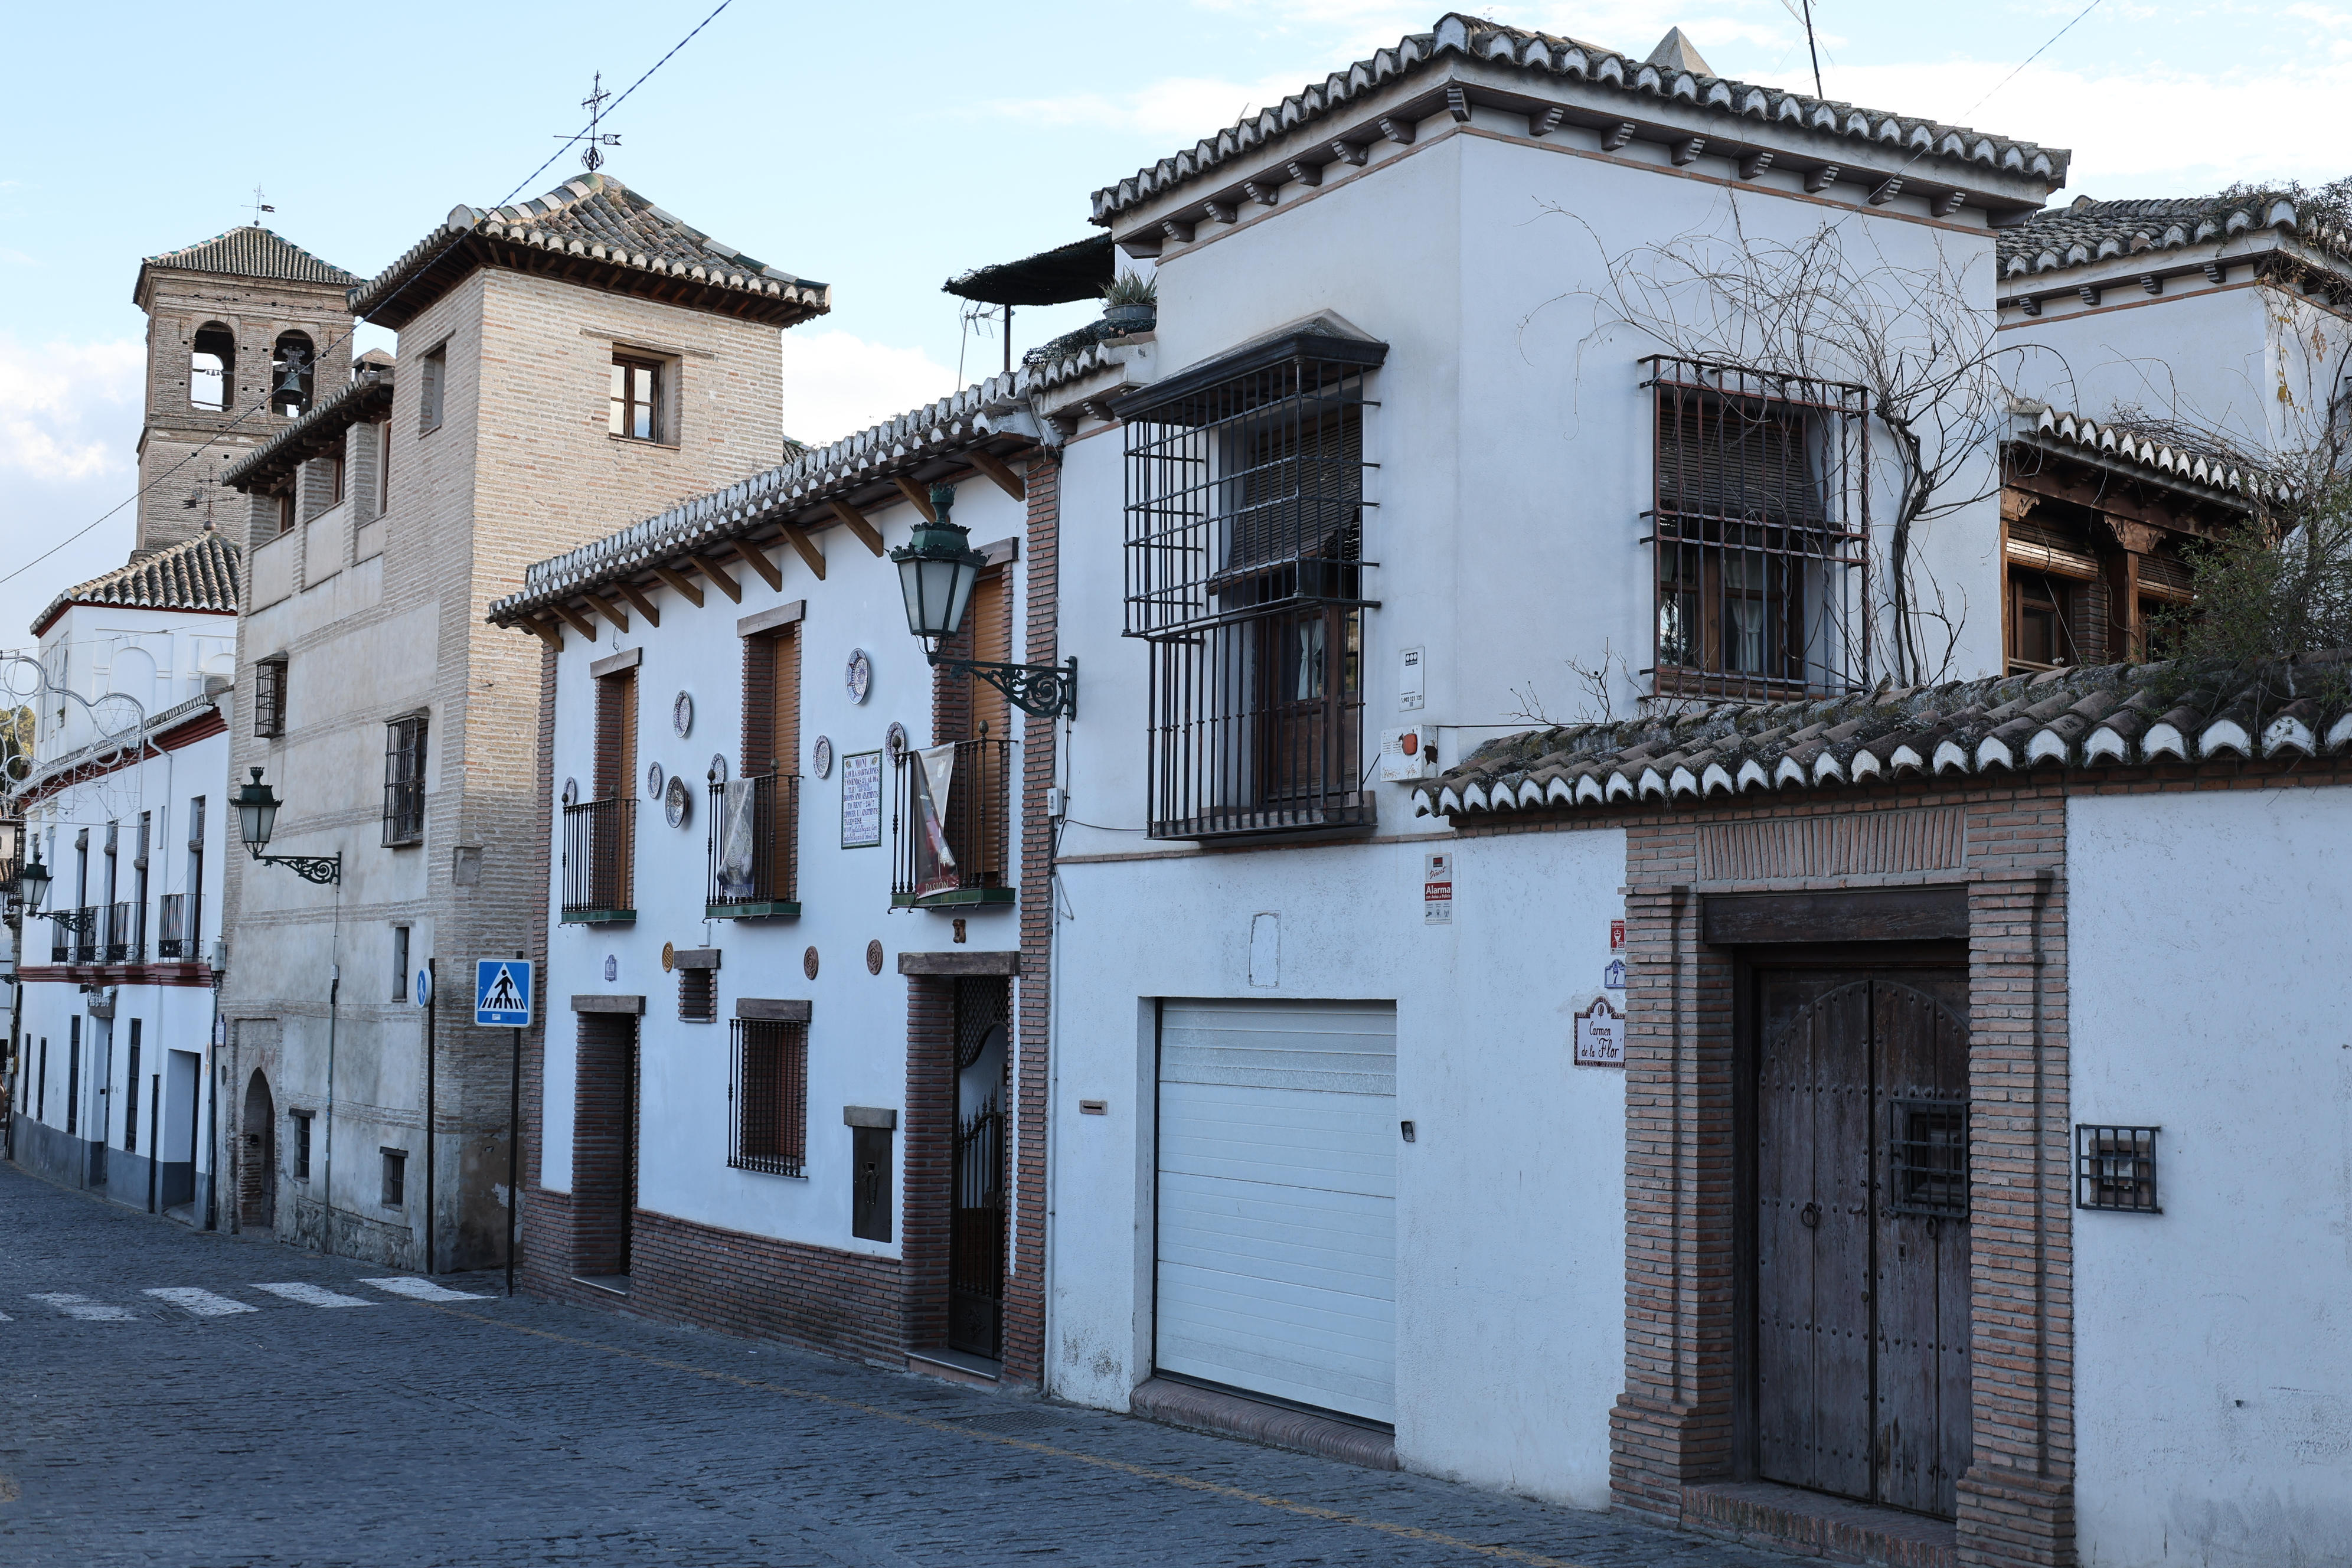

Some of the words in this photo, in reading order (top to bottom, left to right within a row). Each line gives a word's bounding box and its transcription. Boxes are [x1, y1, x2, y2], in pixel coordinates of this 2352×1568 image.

[855, 758, 867, 769] MONI
[1429, 865, 1447, 880] Direct
[925, 879, 949, 893] PASIÓN
[1426, 885, 1451, 894] Alarma
[1613, 971, 1618, 984] 7
[1589, 1021, 1611, 1035] Carmen
[1582, 1044, 1587, 1057] de
[1590, 1044, 1595, 1057] la
